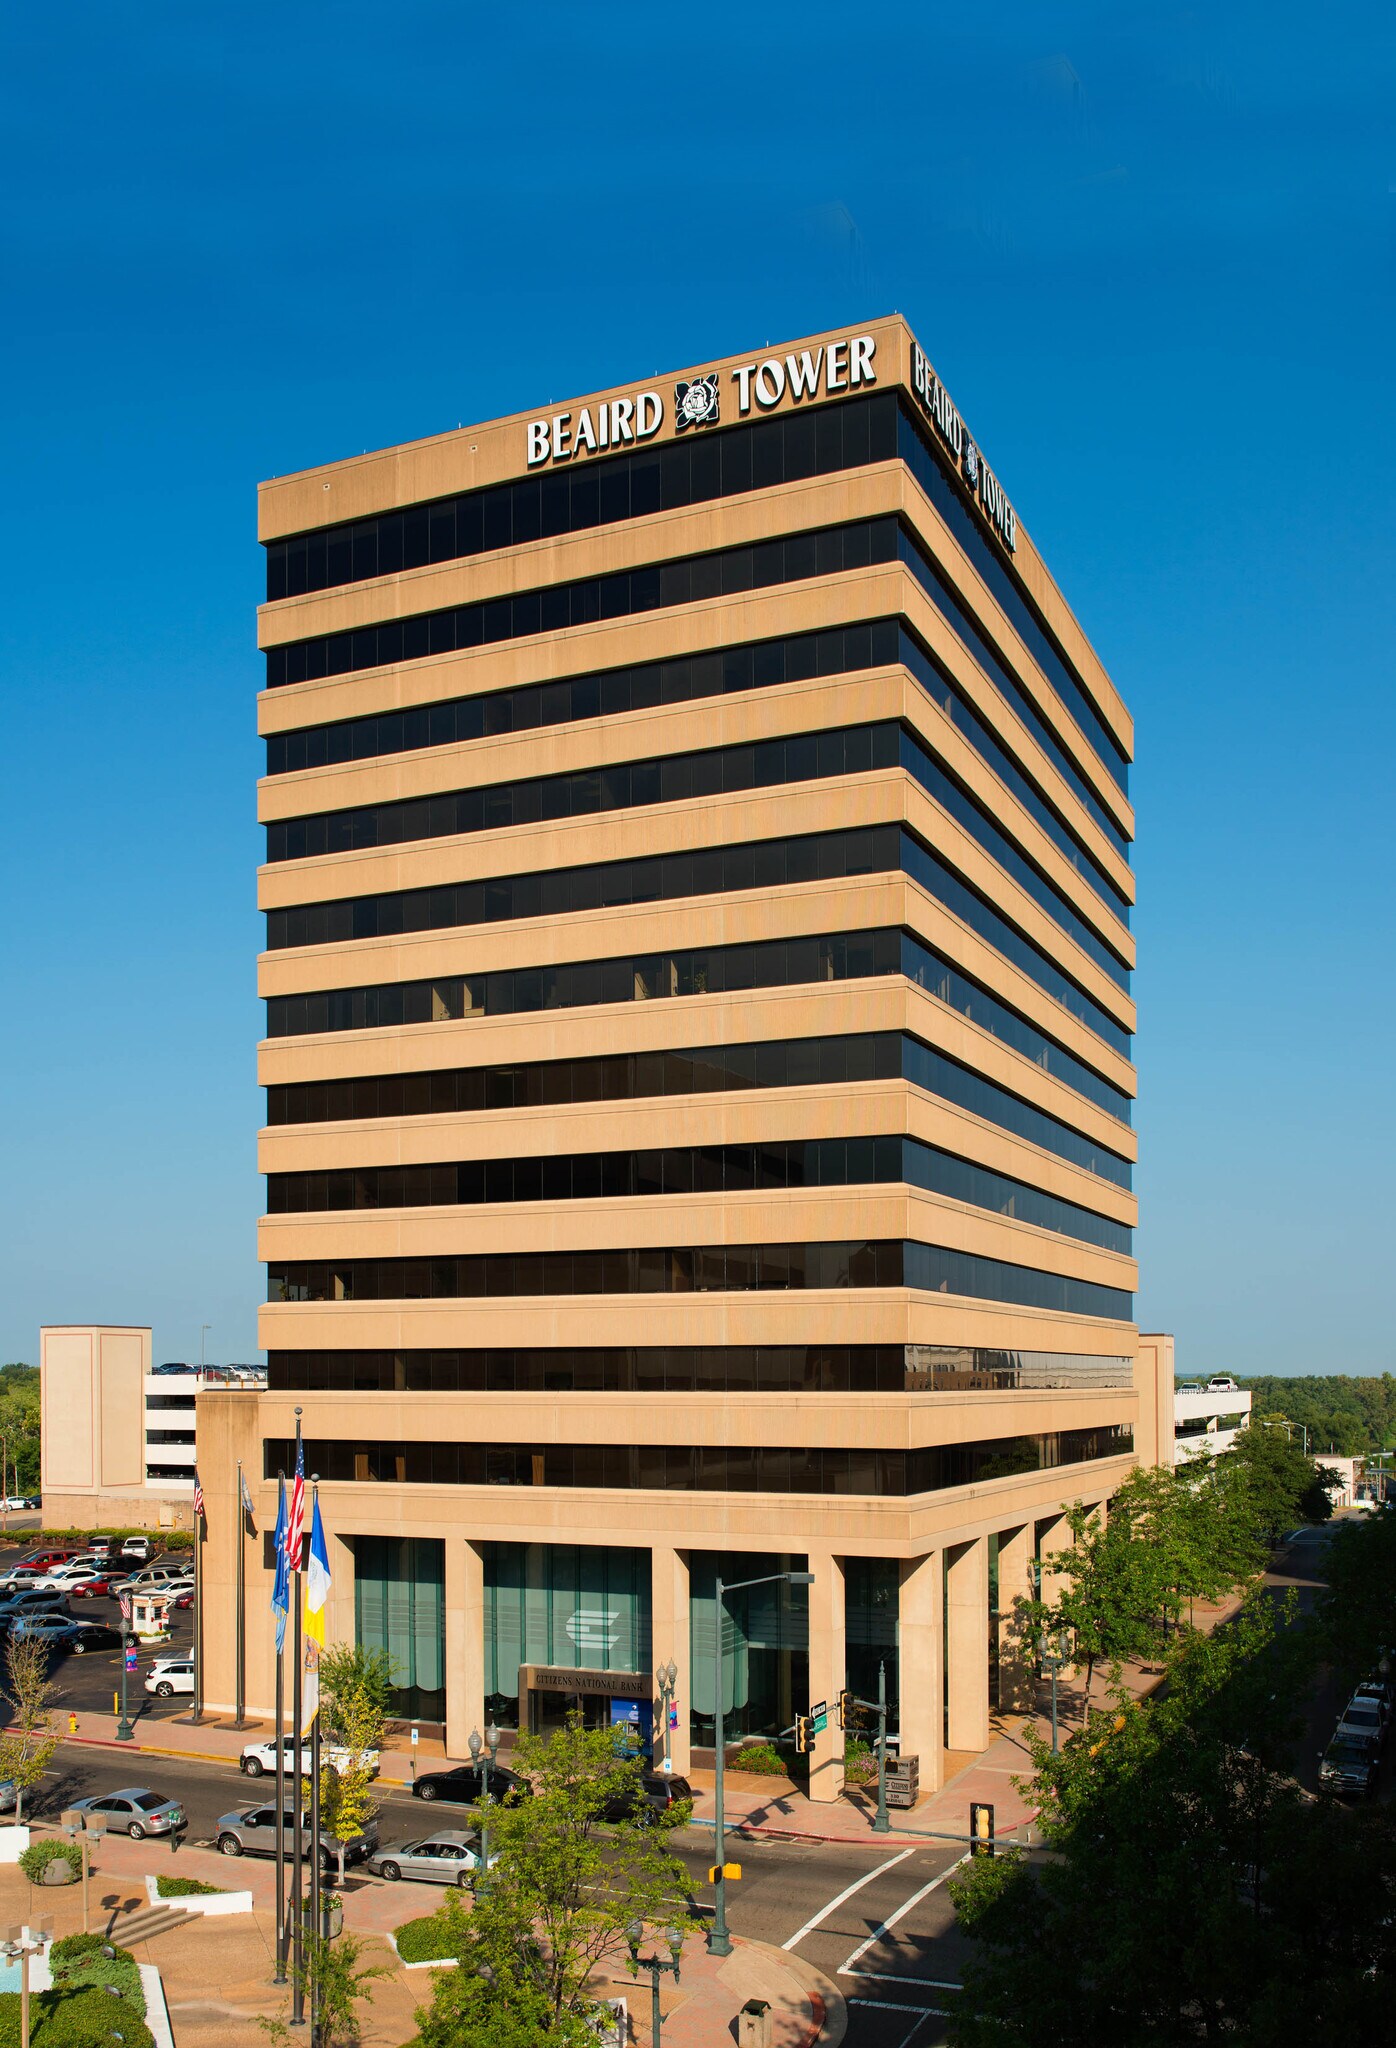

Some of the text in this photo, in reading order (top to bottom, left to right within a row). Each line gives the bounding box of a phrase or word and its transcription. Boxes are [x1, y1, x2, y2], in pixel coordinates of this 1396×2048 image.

[527, 335, 877, 466] BEAIRD TOWER
[911, 342, 1017, 553] BEAIRD TOWER
[536, 1674, 644, 1692] CITIZENS NATIONAL BANK
